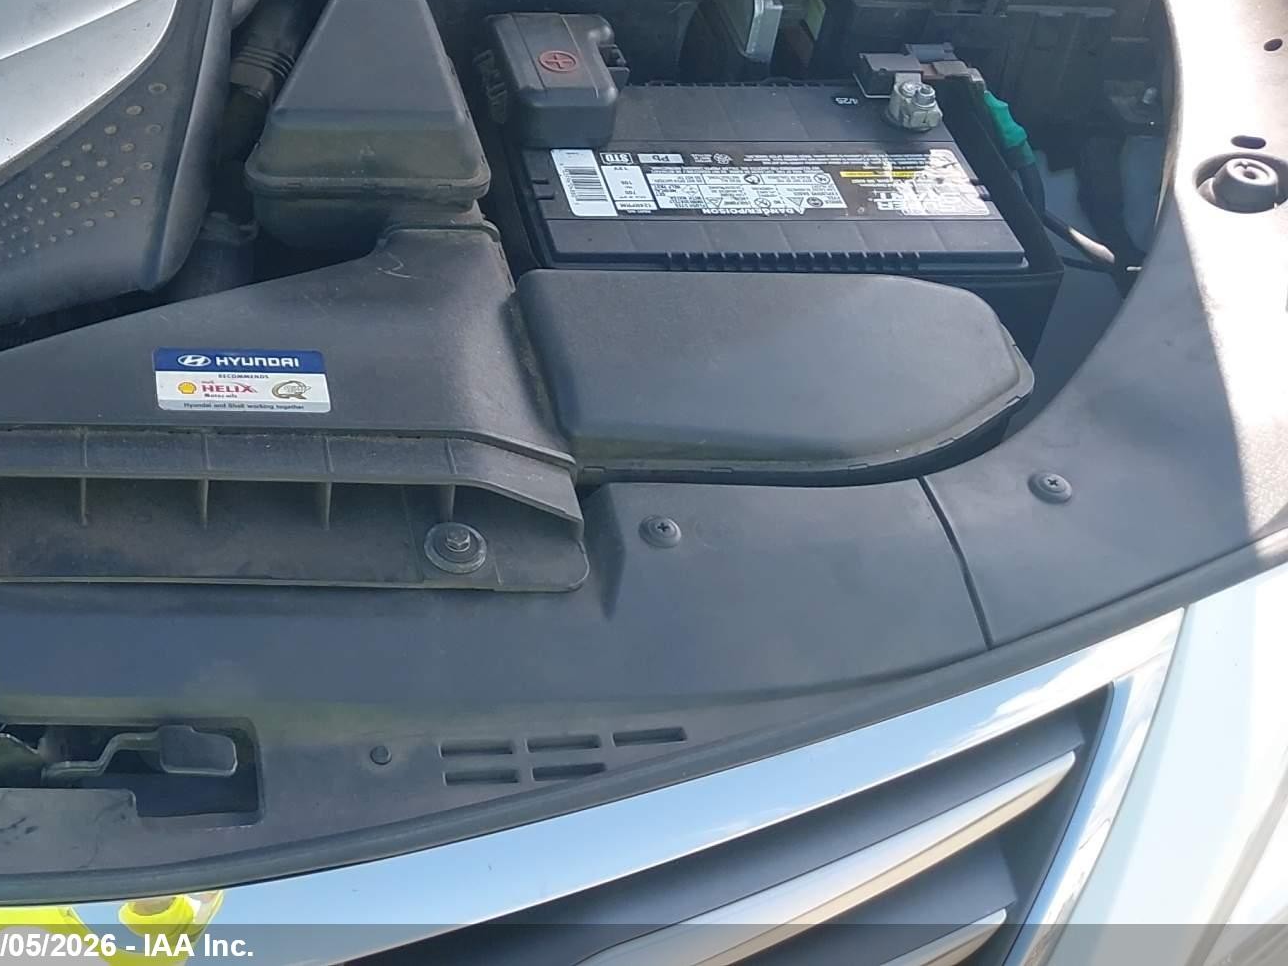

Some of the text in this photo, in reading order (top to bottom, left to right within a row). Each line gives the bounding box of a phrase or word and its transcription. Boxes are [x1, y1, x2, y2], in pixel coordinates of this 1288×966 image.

[702, 207, 794, 215] DANGER/POISON
[215, 356, 299, 367] HYUNDAI
[201, 384, 254, 393] HELIX
